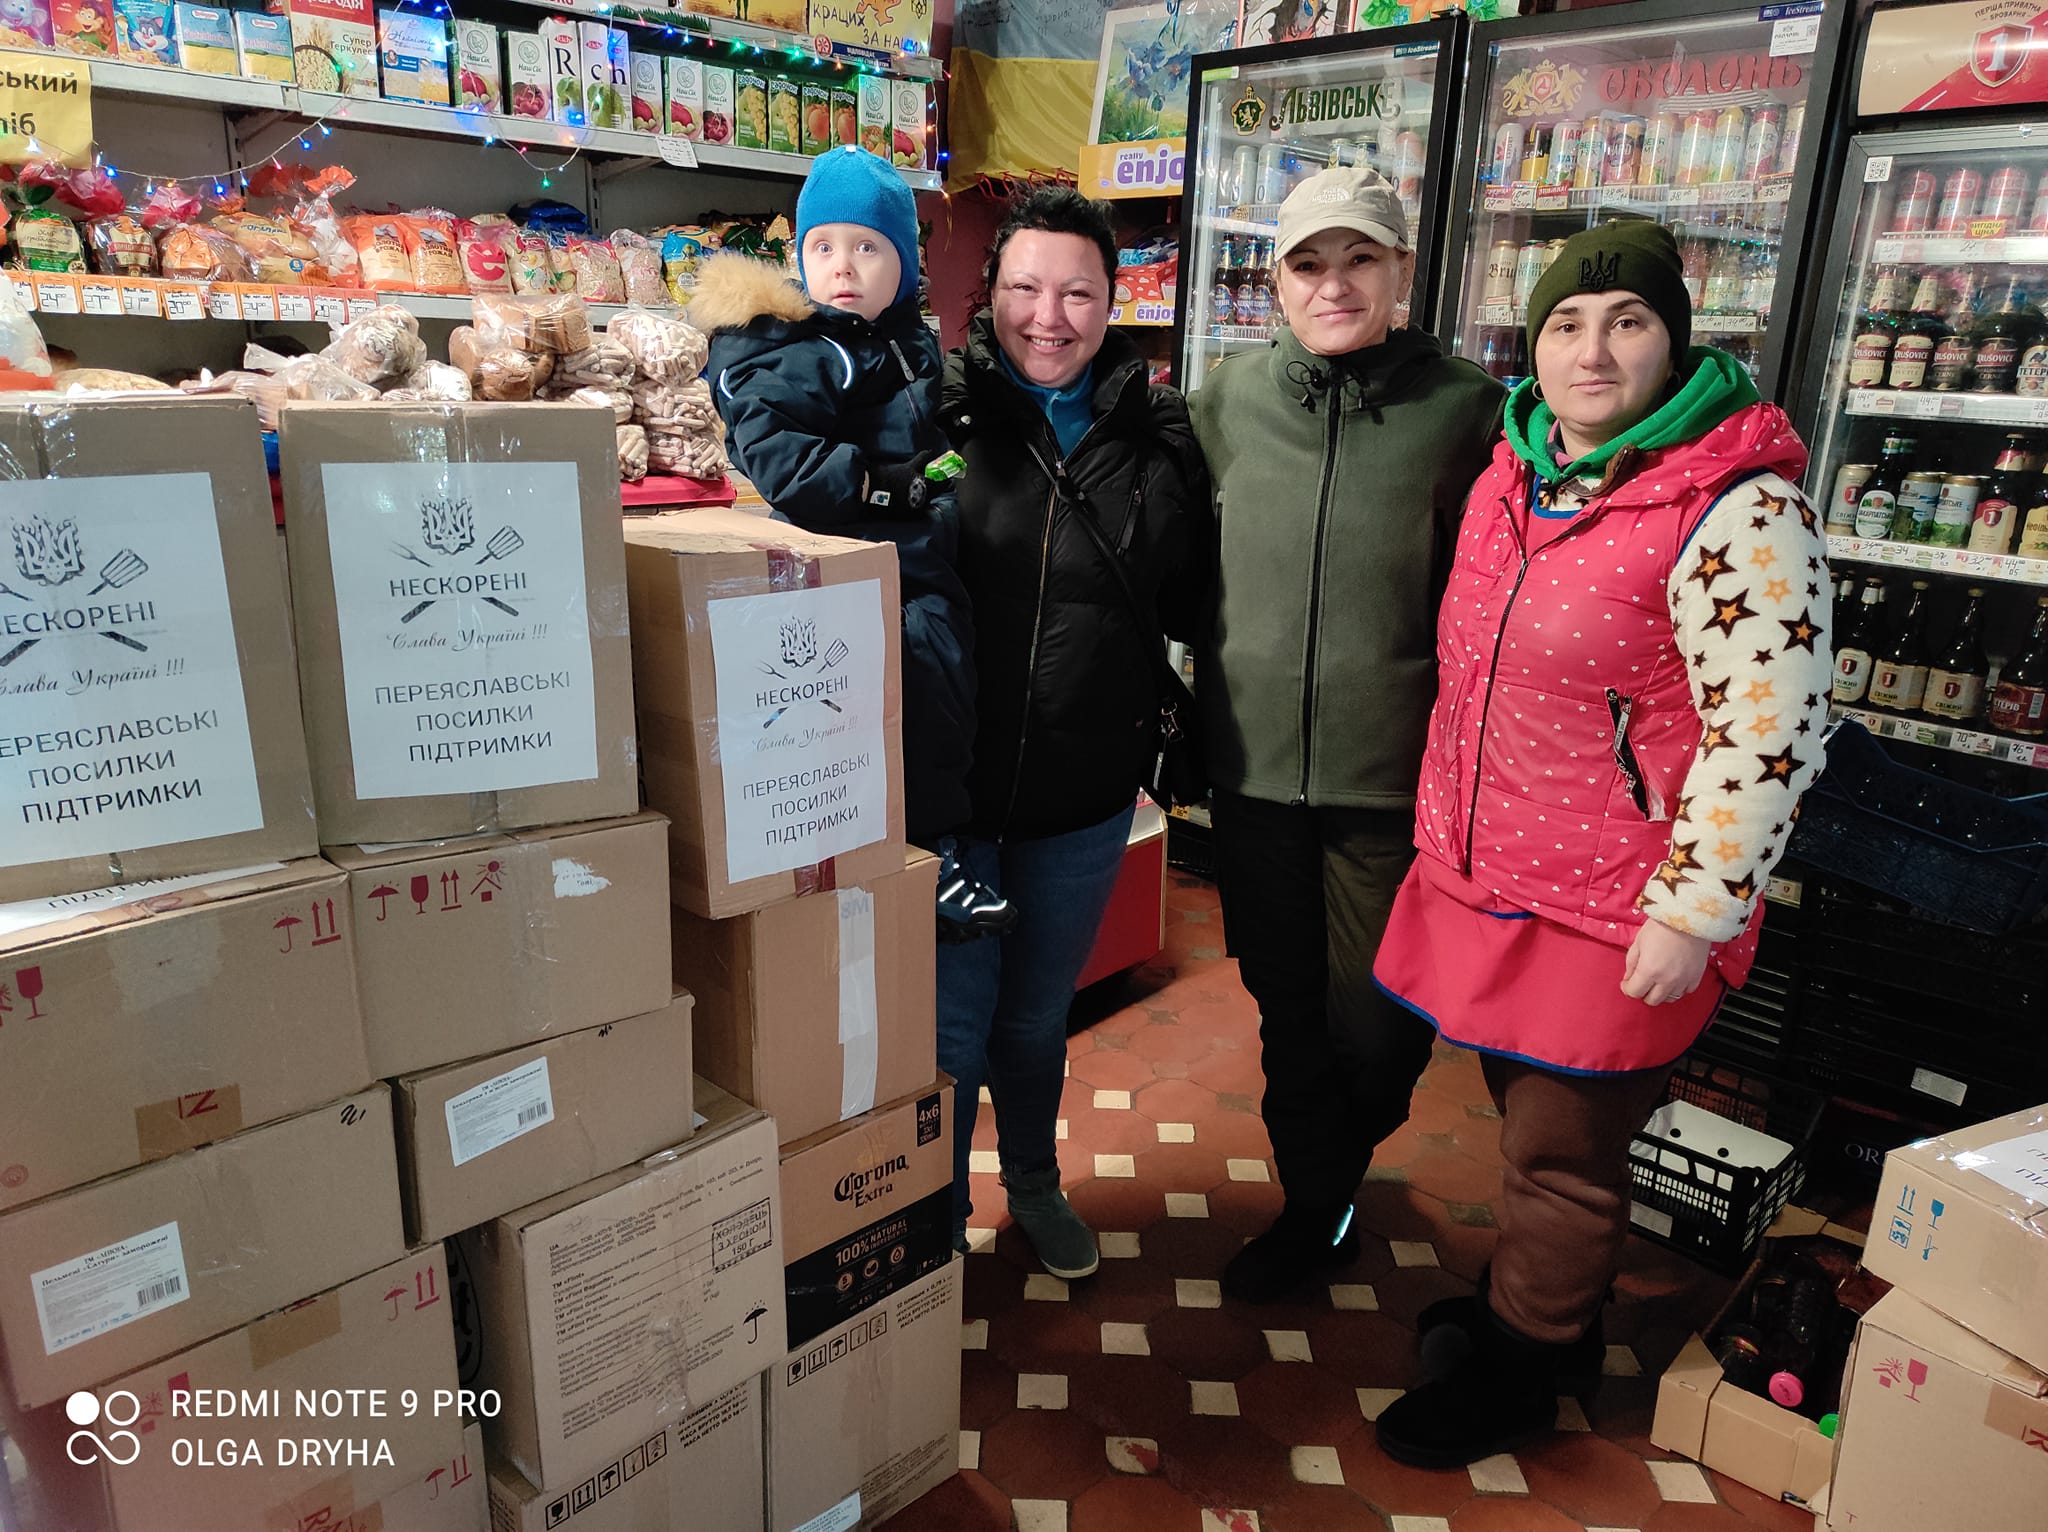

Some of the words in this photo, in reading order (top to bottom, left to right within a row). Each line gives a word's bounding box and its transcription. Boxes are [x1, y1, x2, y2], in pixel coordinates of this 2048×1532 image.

[813, 4, 866, 28] КРАЩИХ
[1785, 4, 1819, 16] IceStream
[1974, 4, 2003, 18] ПЕРША
[2003, 1, 2041, 13] ПРИВАТНА
[342, 34, 372, 48] Супер
[863, 29, 879, 45] ЗА
[1984, 32, 2010, 72] 1
[1600, 54, 1802, 101] ОБОЛОНЬ
[1268, 80, 1400, 131] ЛЬВІВСЬКЕ
[1117, 149, 1185, 185] enjo
[1119, 151, 1143, 161] really
[389, 572, 527, 598] НЕСКОРЕНІ
[0, 600, 156, 636] ЕСКОРЕНІ
[386, 631, 447, 650] Слава
[451, 627, 526, 652] Україні
[66, 664, 158, 697] Україні
[375, 671, 572, 705] ПЕРЕЯСЛАВСЬКІ
[756, 675, 849, 708] НЕСКОРЕНІ
[0, 709, 219, 759] ЕРЕЯСЛАВСЬКІ
[416, 704, 534, 732] ПОСИЛКИ
[408, 731, 552, 764] ПІДТРИМКИ
[752, 735, 796, 753] Слава
[799, 723, 846, 749] Україні
[28, 749, 177, 789] ПОСИЛКИ
[743, 752, 871, 800] ПЕРЕЯСЛАВСЬКІ
[22, 778, 203, 824] ПІДТРИМКИ
[771, 784, 848, 819] ПОСИЛКИ
[765, 805, 859, 846] ПІДТРИМКИ
[918, 1103, 939, 1122] 4x6
[1845, 1143, 1883, 1166] OR
[833, 1154, 910, 1202] Corona
[855, 1183, 894, 1209] Extra
[835, 1237, 870, 1267] 100%
[870, 1219, 907, 1243] NATURAL
